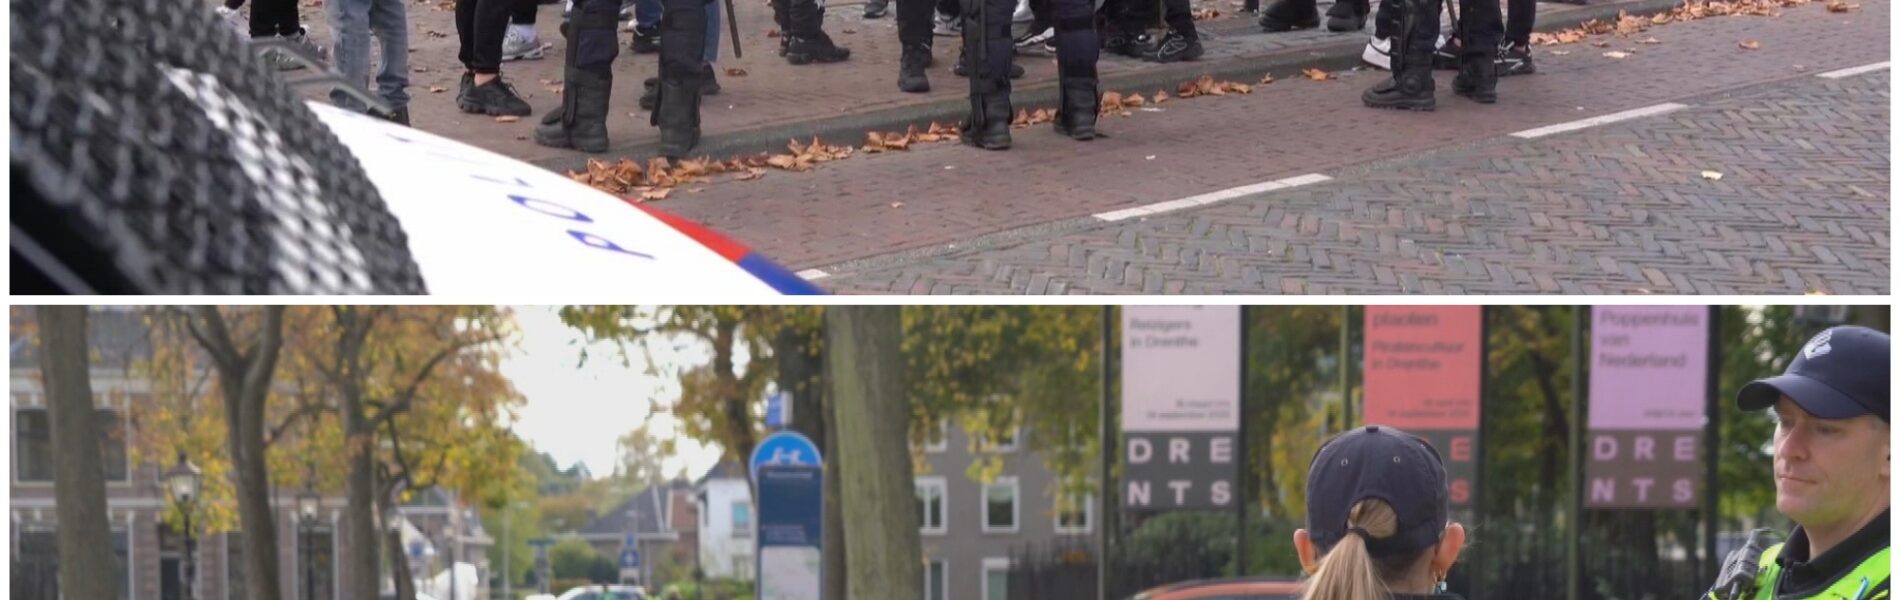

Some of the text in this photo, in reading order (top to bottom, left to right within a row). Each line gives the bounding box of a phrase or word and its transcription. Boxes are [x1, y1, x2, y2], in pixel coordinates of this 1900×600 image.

[1601, 310, 1700, 329] Poppenhuis
[1145, 336, 1199, 349] Drenthe
[1601, 335, 1630, 348] van
[1600, 353, 1688, 369] Nederland
